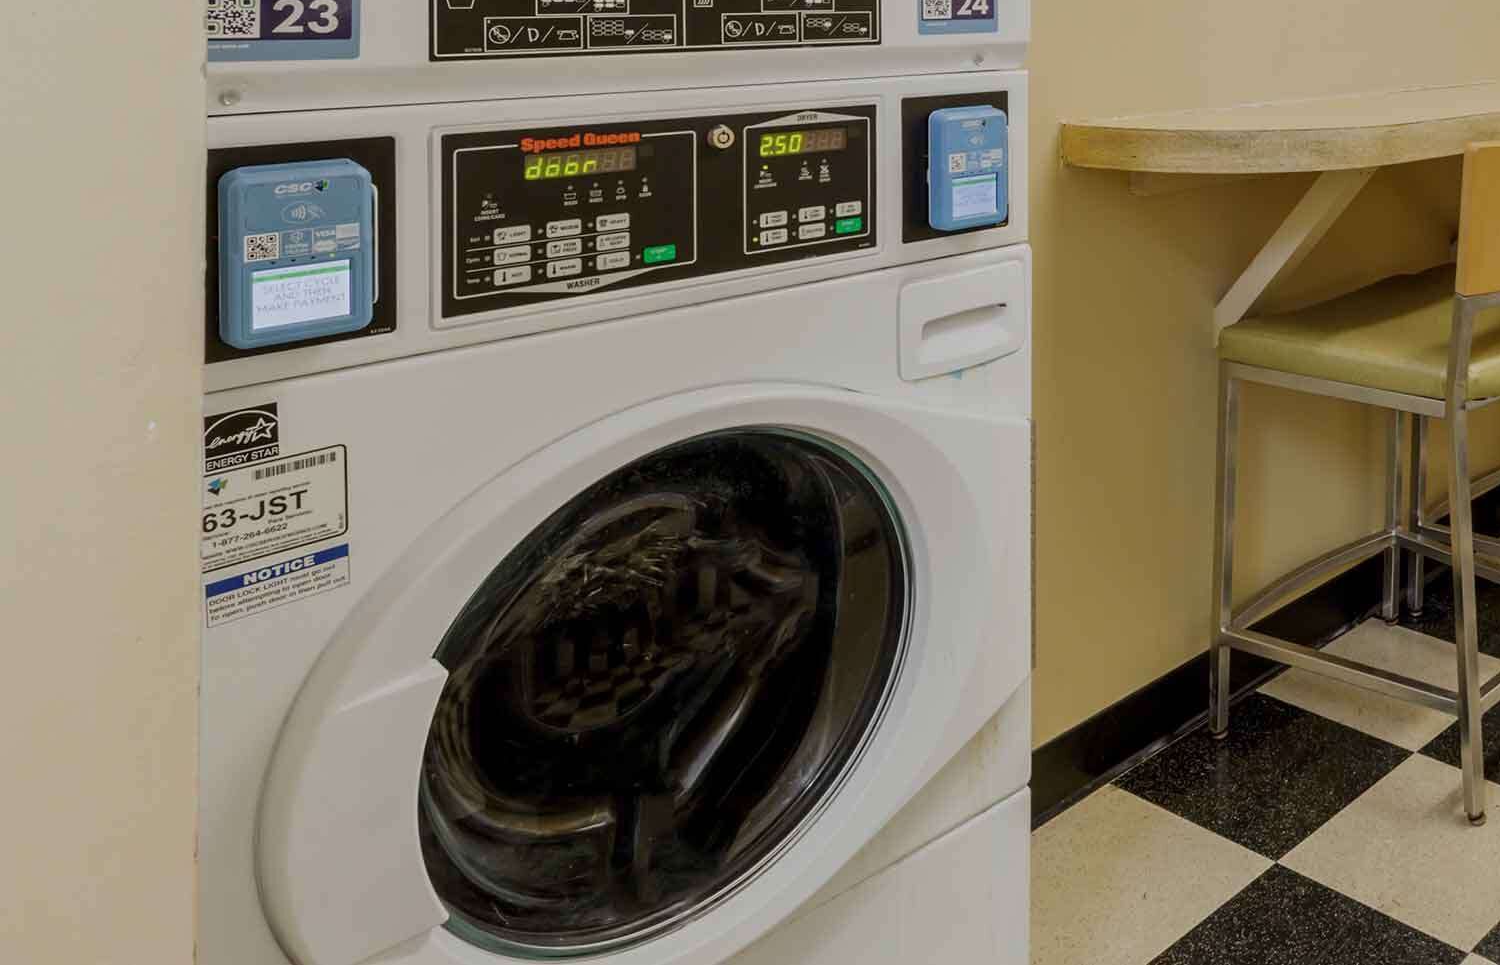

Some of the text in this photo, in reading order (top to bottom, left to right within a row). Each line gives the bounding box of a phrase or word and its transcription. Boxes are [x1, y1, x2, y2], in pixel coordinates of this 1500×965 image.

[521, 132, 641, 153] Speed Queen
[525, 157, 597, 180] door
[274, 182, 313, 195] CSC
[566, 277, 601, 290] WASHER
[206, 446, 279, 470] ENERGY STAR
[202, 489, 308, 533] 63-JST
[212, 523, 289, 548] 1-877-264-6622
[243, 555, 316, 586] NOTICE
[208, 594, 236, 607] DOOR
[237, 586, 261, 600] LOCK
[263, 578, 288, 591] LIGHT
[311, 568, 322, 577] go
[208, 602, 236, 615] before
[236, 588, 281, 606] attempting
[282, 584, 291, 593] to
[291, 578, 312, 590] open
[246, 599, 267, 612] push
[268, 592, 287, 605] door
